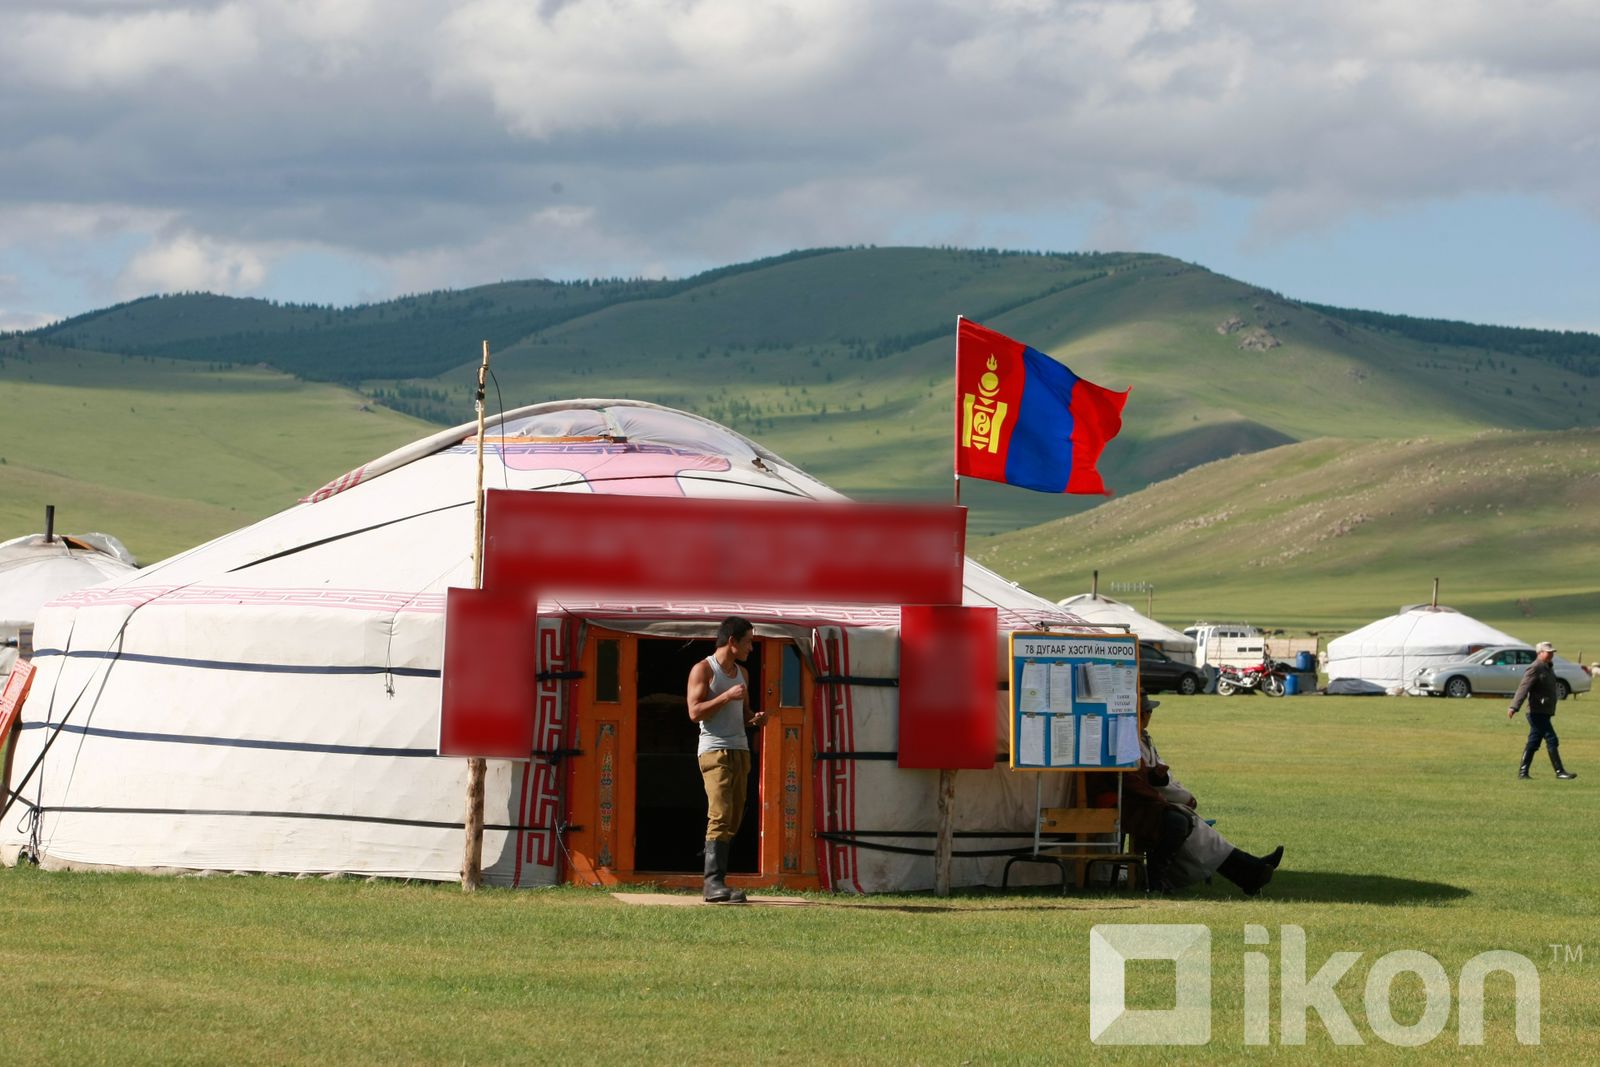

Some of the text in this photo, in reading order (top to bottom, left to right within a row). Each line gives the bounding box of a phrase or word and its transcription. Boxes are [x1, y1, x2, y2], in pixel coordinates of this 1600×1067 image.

[1025, 644, 1035, 655] 78
[1036, 645, 1066, 655] ДУГААР
[1107, 646, 1134, 656] ХОРОО
